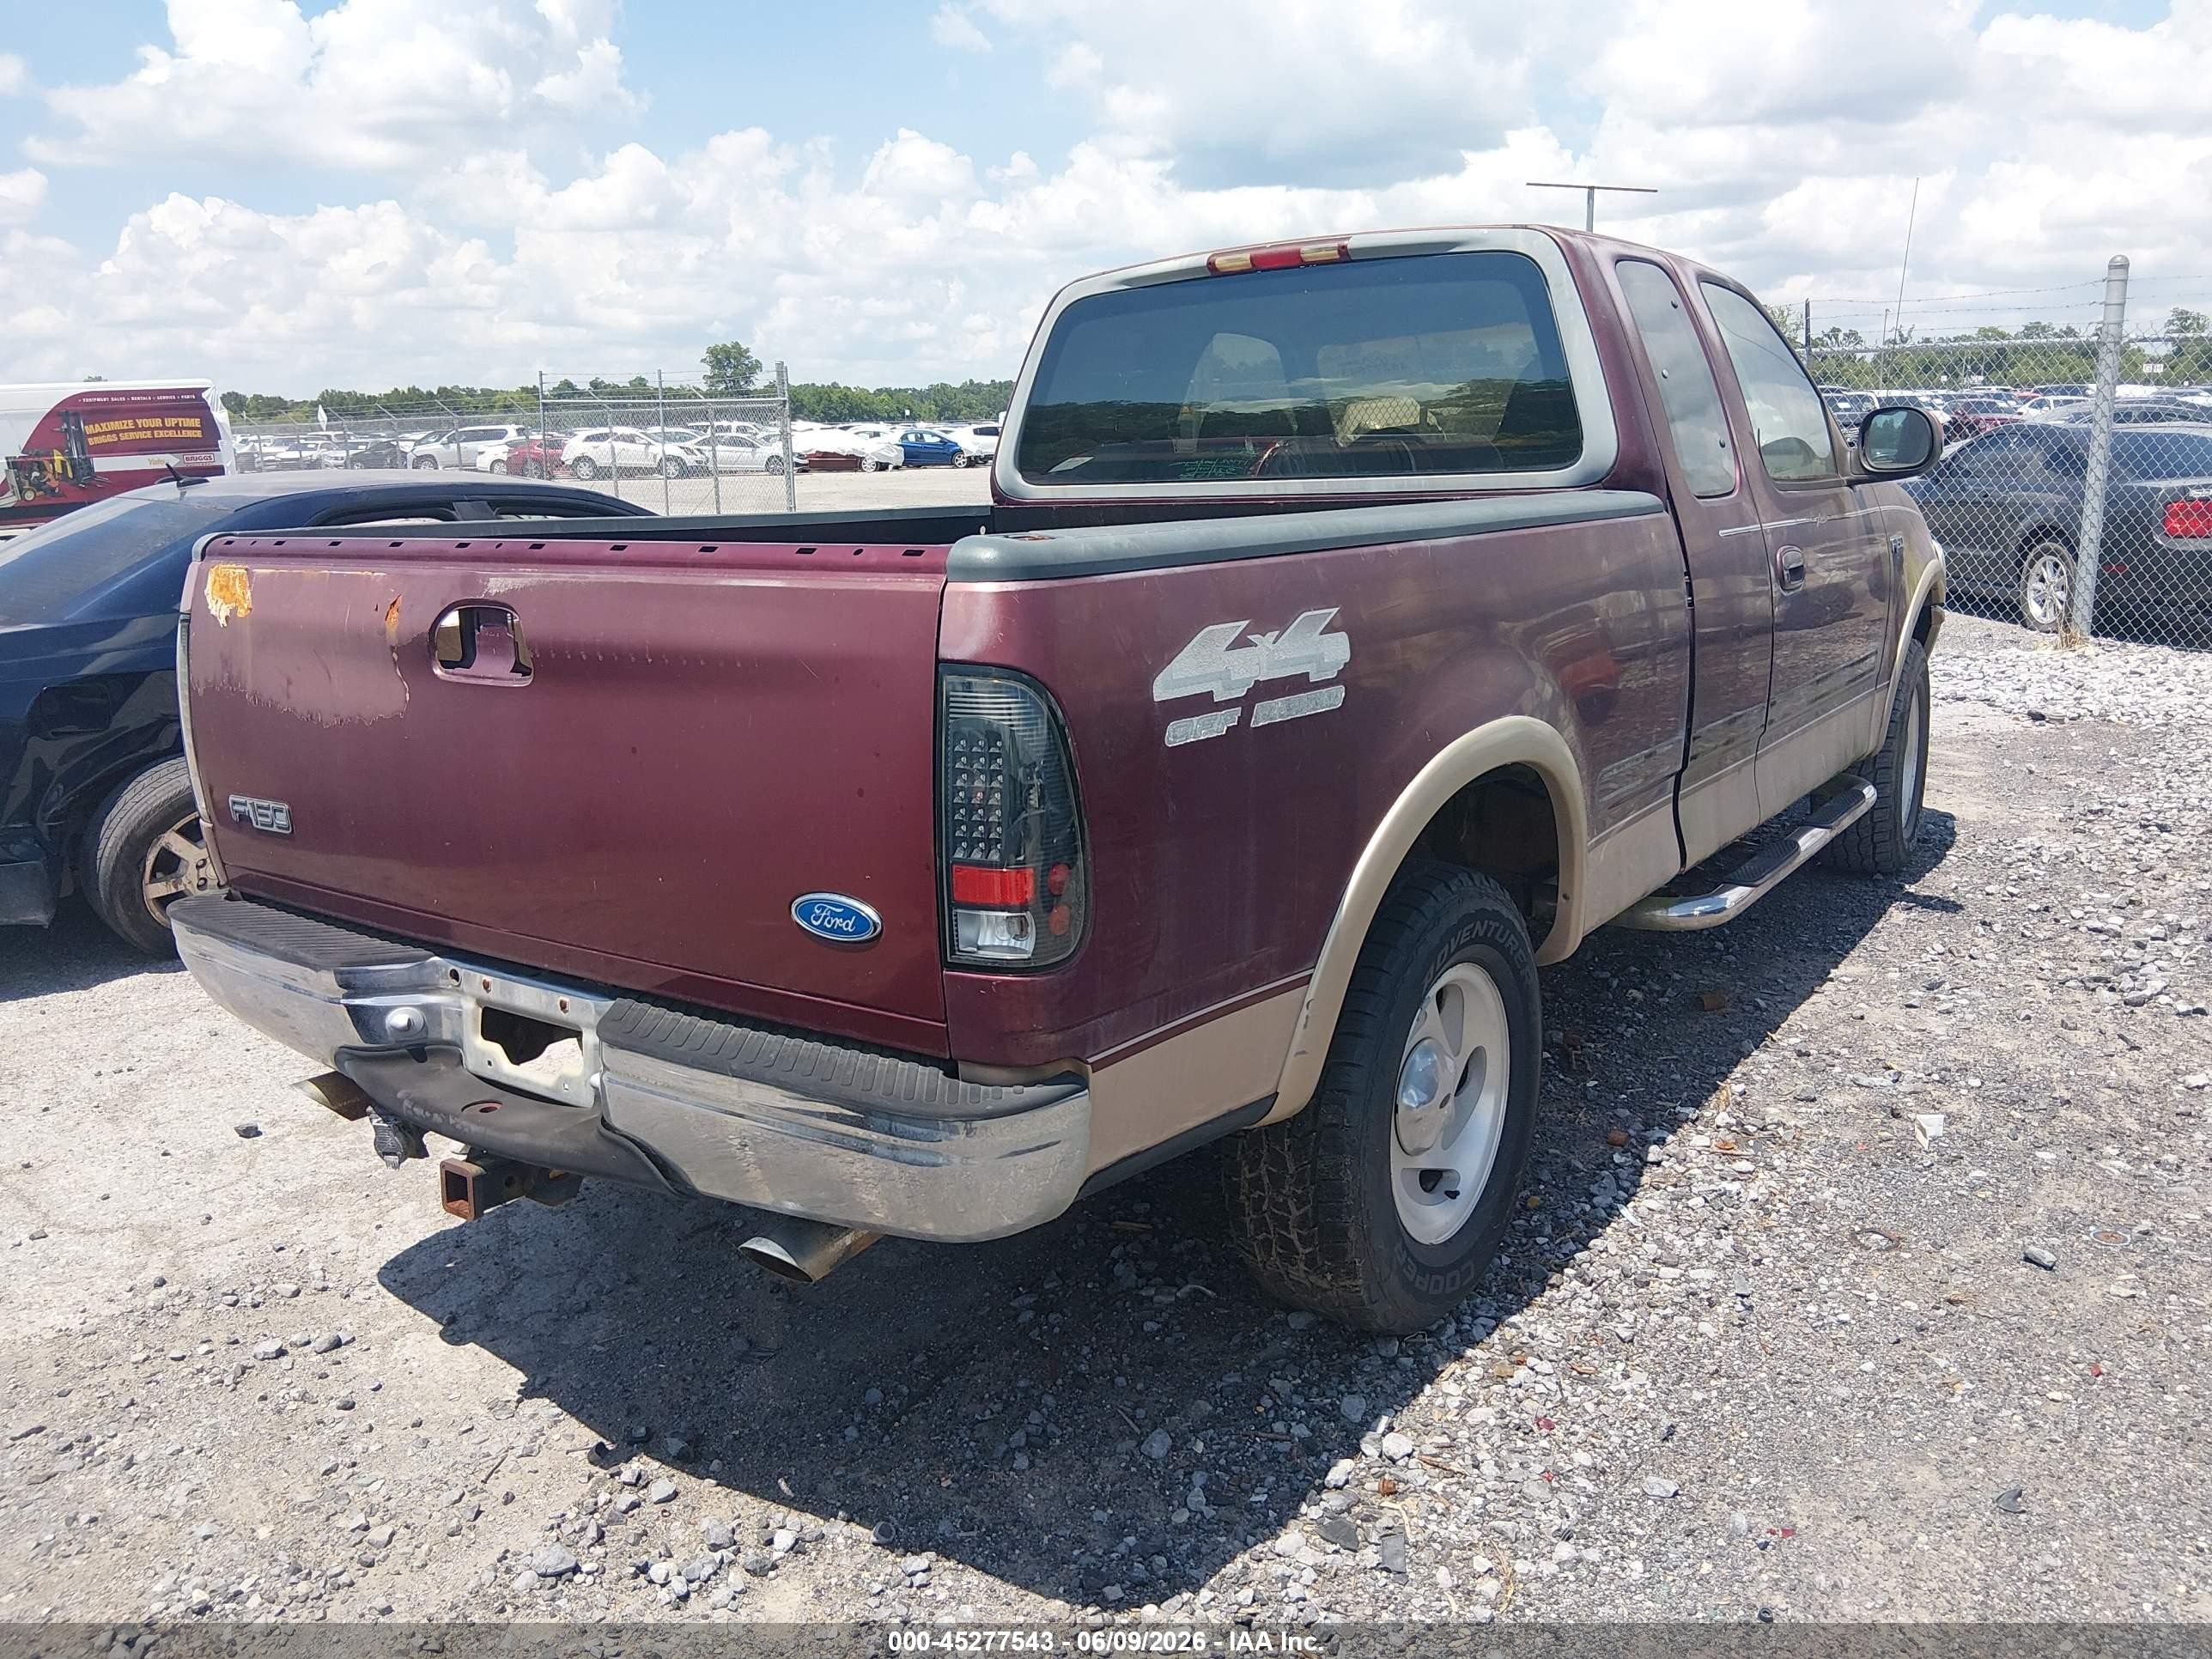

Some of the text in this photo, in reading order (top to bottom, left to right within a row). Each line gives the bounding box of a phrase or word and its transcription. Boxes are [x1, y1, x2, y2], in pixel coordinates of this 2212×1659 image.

[85, 417, 201, 434] MAXIMIZE YOUR UPTIME
[88, 429, 203, 446] BRIGGS SERVICE EXCELLENCE
[811, 902, 856, 933] Ford
